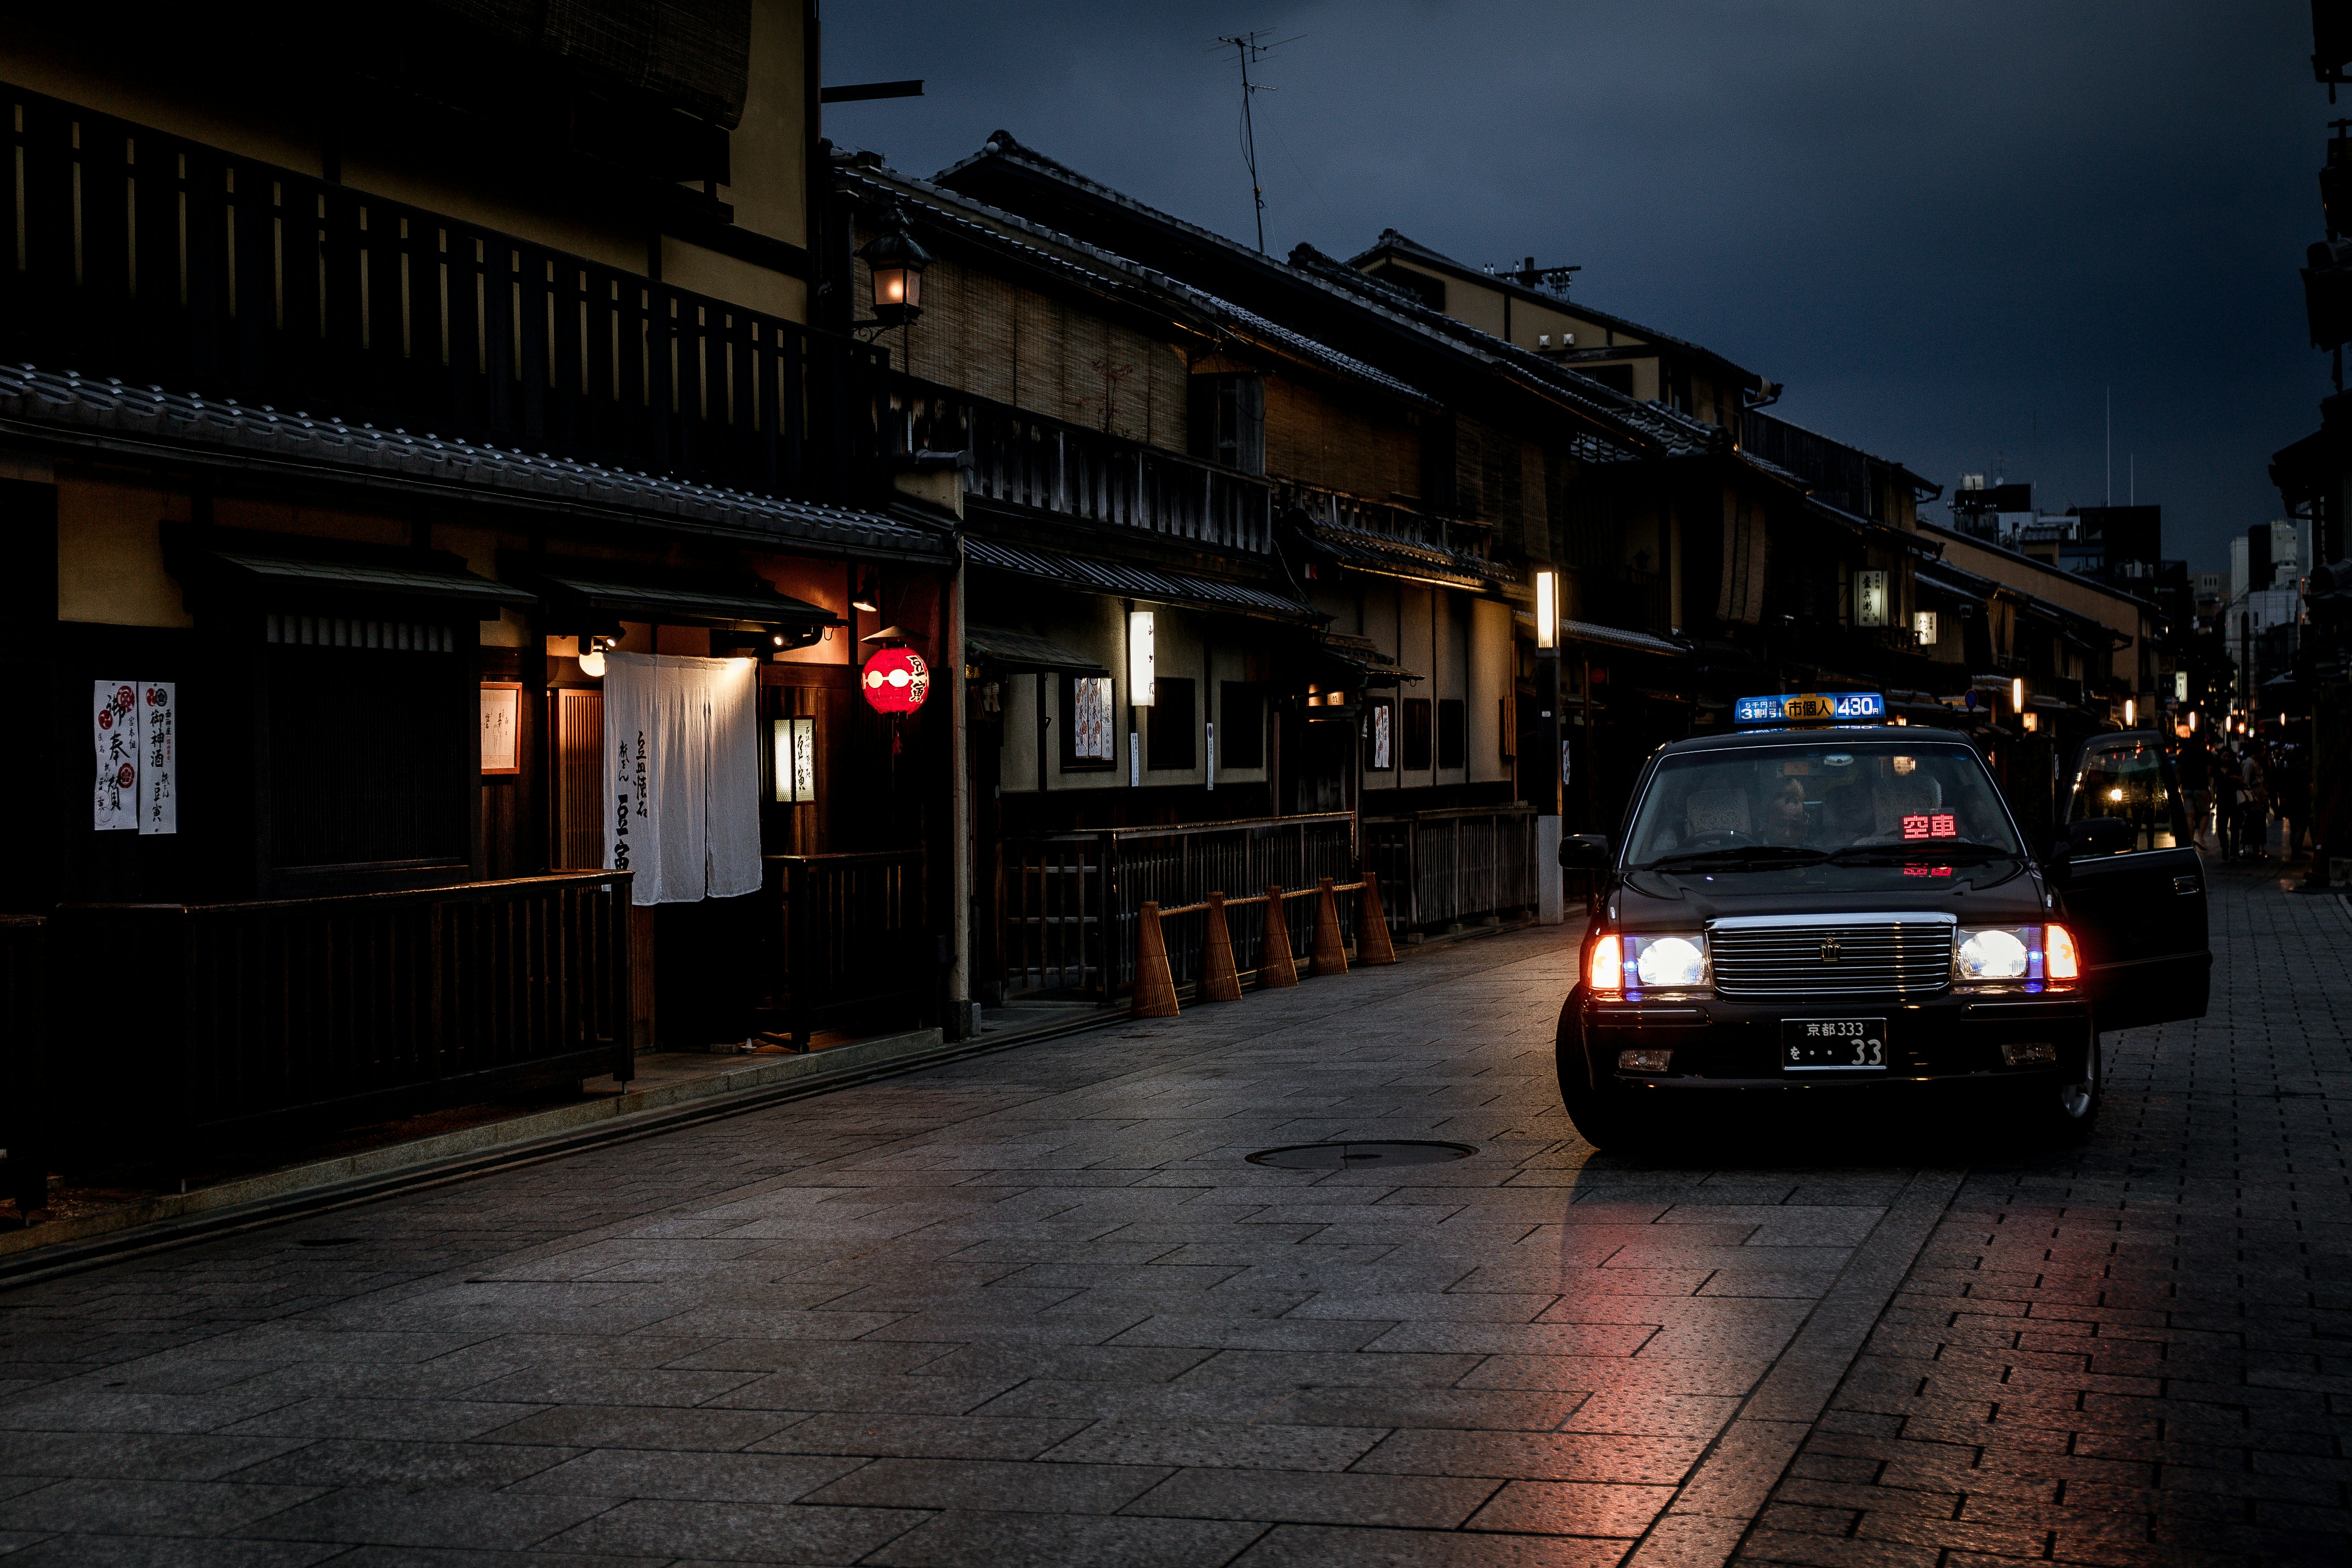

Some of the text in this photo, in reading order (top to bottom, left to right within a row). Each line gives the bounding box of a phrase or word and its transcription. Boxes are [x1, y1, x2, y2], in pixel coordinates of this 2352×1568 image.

[907, 655, 926, 702] 豆寅
[1741, 708, 1782, 719] 3割引
[1745, 700, 1777, 709] 5千円超
[1788, 699, 1831, 717] 市個人
[1838, 697, 1879, 716] 430円
[150, 710, 165, 768] 御神酒
[797, 734, 806, 791] 豆寅
[152, 782, 162, 823] 豆寅
[1904, 814, 1956, 839] 空車
